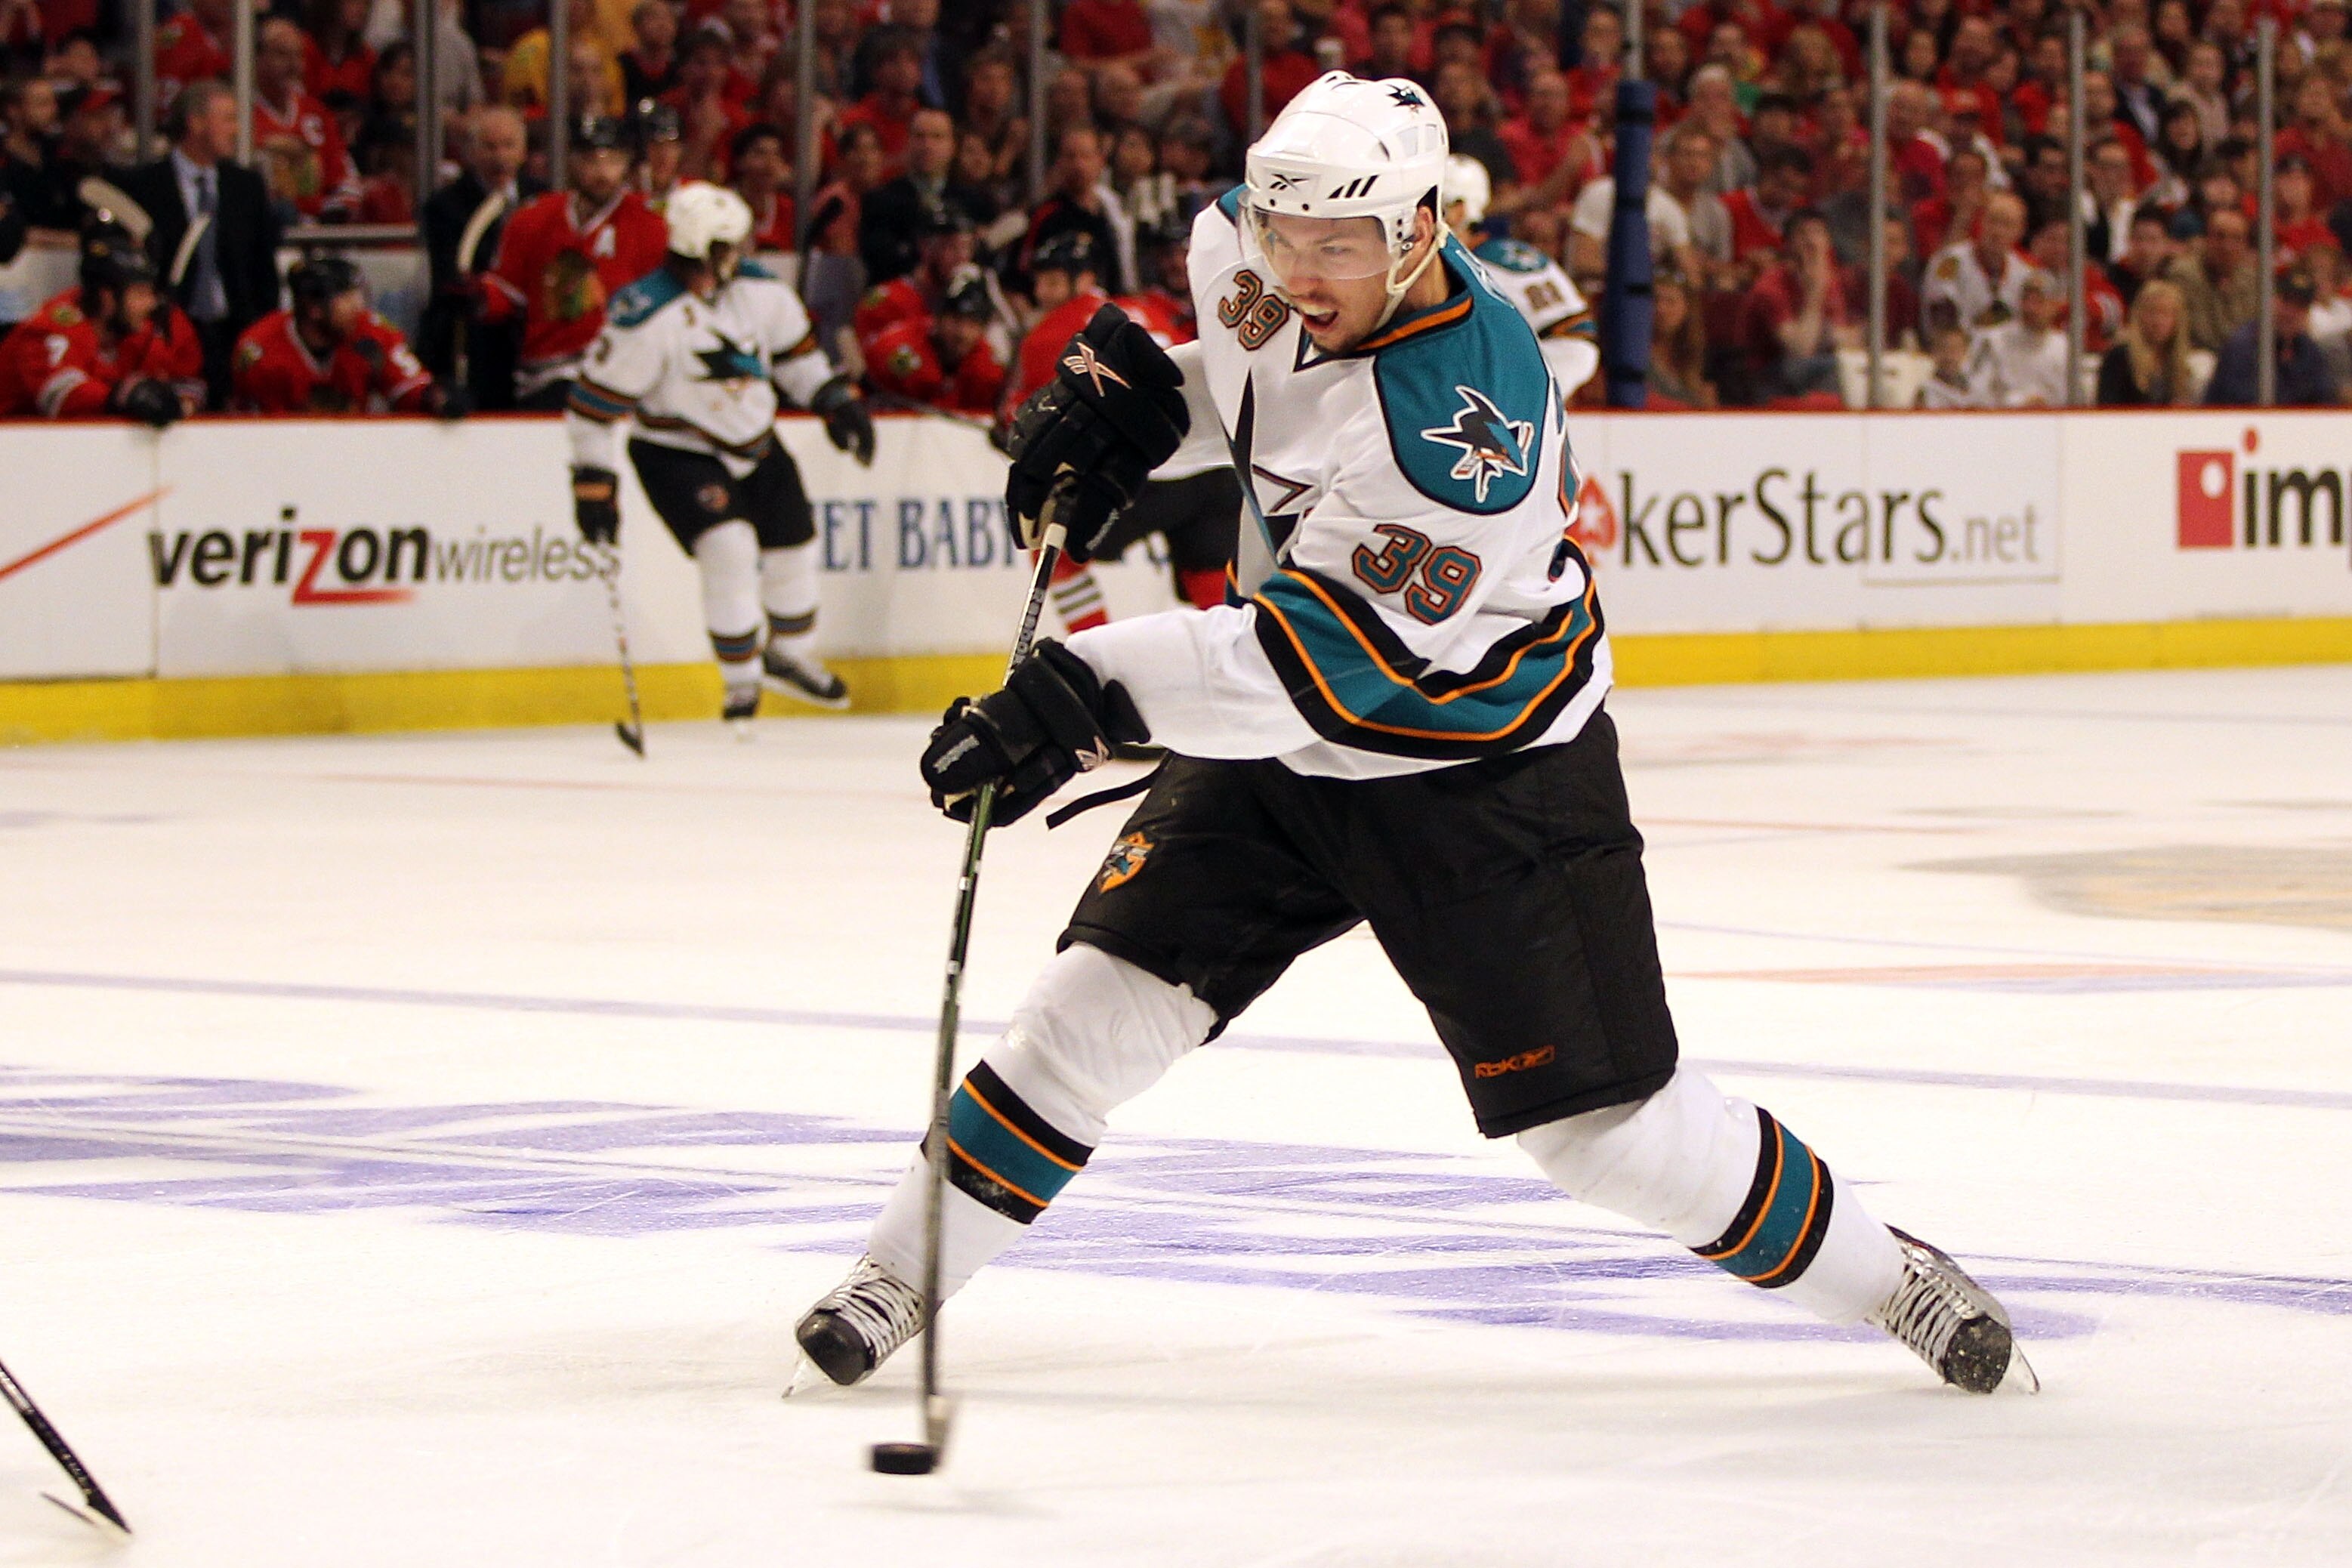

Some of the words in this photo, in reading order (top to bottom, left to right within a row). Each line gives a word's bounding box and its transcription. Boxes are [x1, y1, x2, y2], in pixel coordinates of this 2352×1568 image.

[592, 224, 616, 258] A
[1218, 269, 1289, 351] 39
[2242, 426, 2352, 572] im
[147, 507, 430, 607] verizon
[1351, 523, 1483, 626] 39
